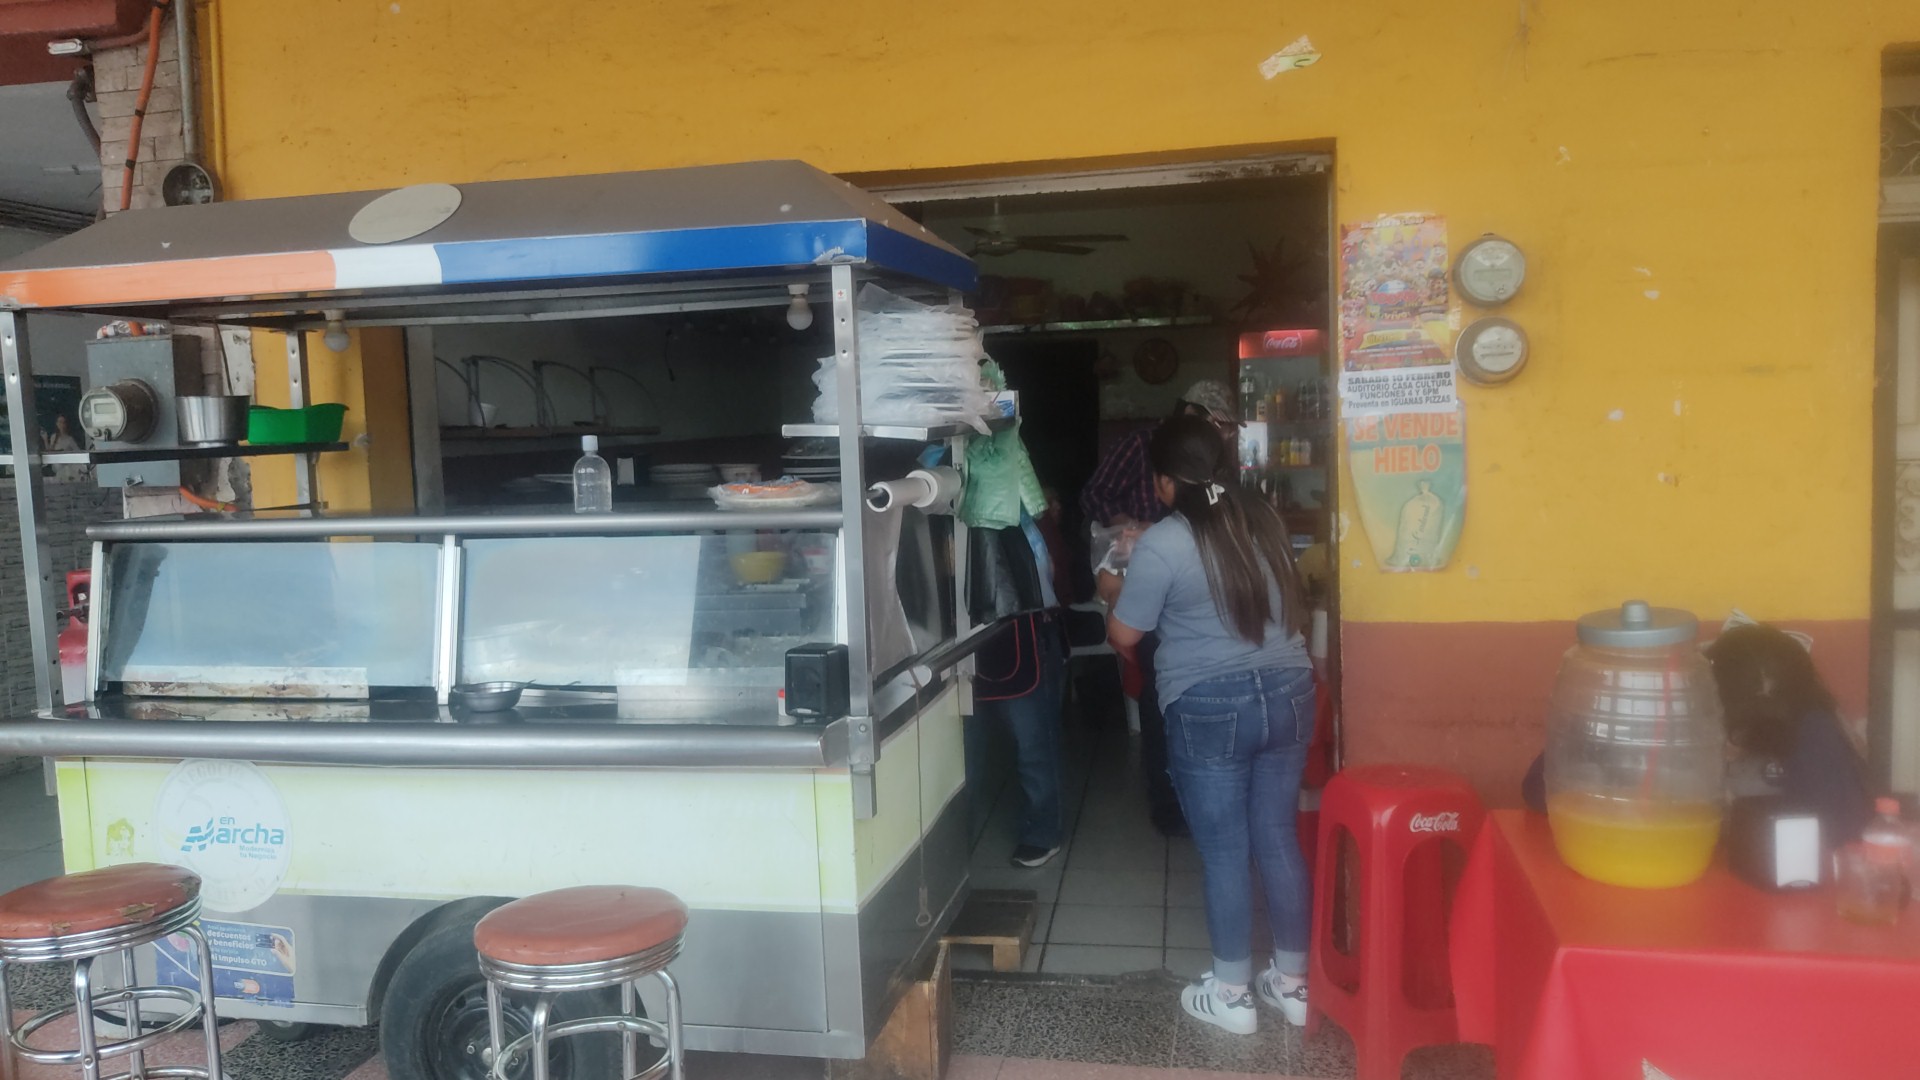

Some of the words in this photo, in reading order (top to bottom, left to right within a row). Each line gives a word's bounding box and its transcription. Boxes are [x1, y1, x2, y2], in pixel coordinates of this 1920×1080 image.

[1347, 383, 1390, 393] AUDITORIO
[1392, 381, 1413, 389] CASA
[1415, 379, 1453, 389] CULTURA
[1360, 390, 1406, 400] FUNCIONES
[1415, 388, 1421, 396] Y
[1422, 388, 1440, 396] 6PM
[1348, 400, 1379, 409] Preventa
[1391, 396, 1423, 406] IGUANAS
[1425, 394, 1451, 404] PIZZAS
[1353, 415, 1378, 442] SE
[1383, 413, 1459, 440] VENDE
[1373, 443, 1441, 474] HIELO
[1409, 811, 1460, 833] Coca-Cola
[181, 817, 284, 852] Marcha
[207, 930, 251, 941] descuentos
[213, 938, 255, 950] beneficios
[218, 954, 250, 964] Impulso
[250, 958, 267, 967] GTO
